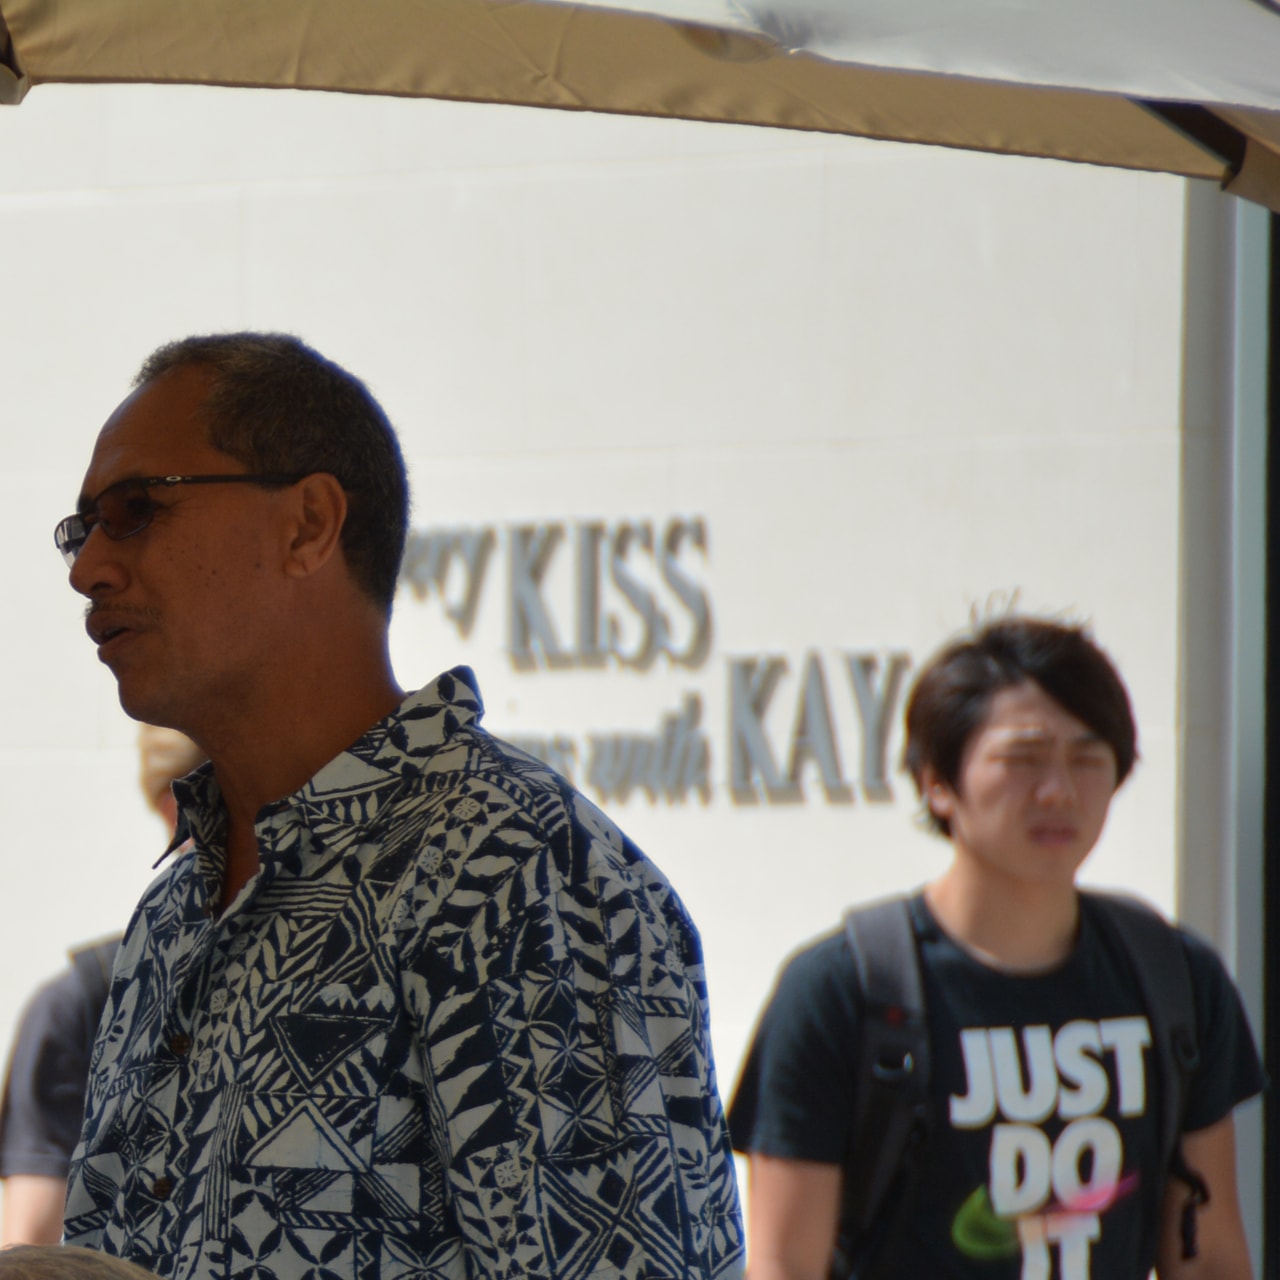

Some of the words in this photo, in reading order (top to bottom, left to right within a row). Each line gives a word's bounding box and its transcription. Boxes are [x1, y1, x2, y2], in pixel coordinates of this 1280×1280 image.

[507, 514, 715, 672] KISS
[726, 649, 913, 806] KAY
[949, 1016, 1152, 1130] JUST
[989, 1116, 1123, 1218] DO
